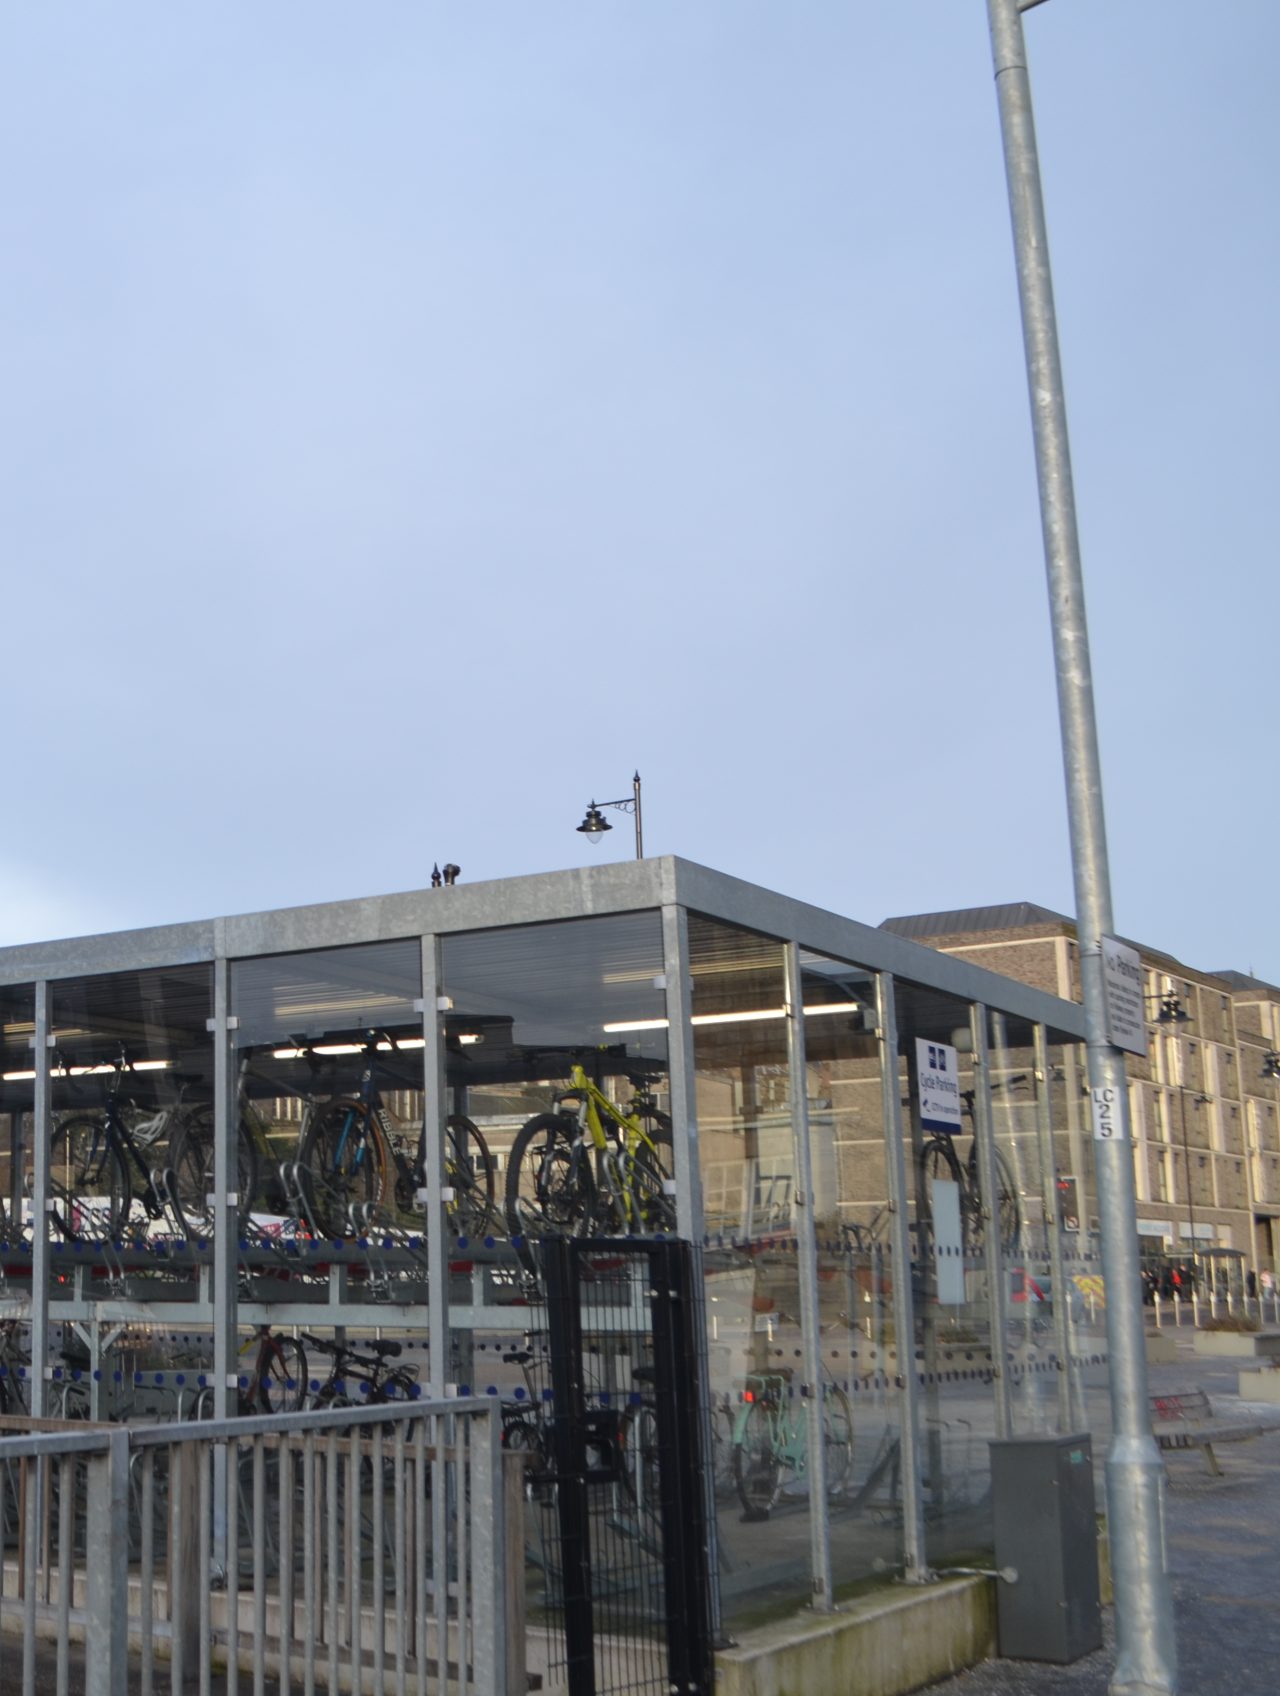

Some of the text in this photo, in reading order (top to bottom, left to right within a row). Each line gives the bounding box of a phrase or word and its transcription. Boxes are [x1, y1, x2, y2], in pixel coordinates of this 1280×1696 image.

[1116, 954, 1140, 986] Parking
[920, 1072, 958, 1098] Cycle Parking
[1093, 1089, 1114, 1103] LC
[1099, 1104, 1111, 1119] 2
[1101, 1122, 1113, 1138] 5
